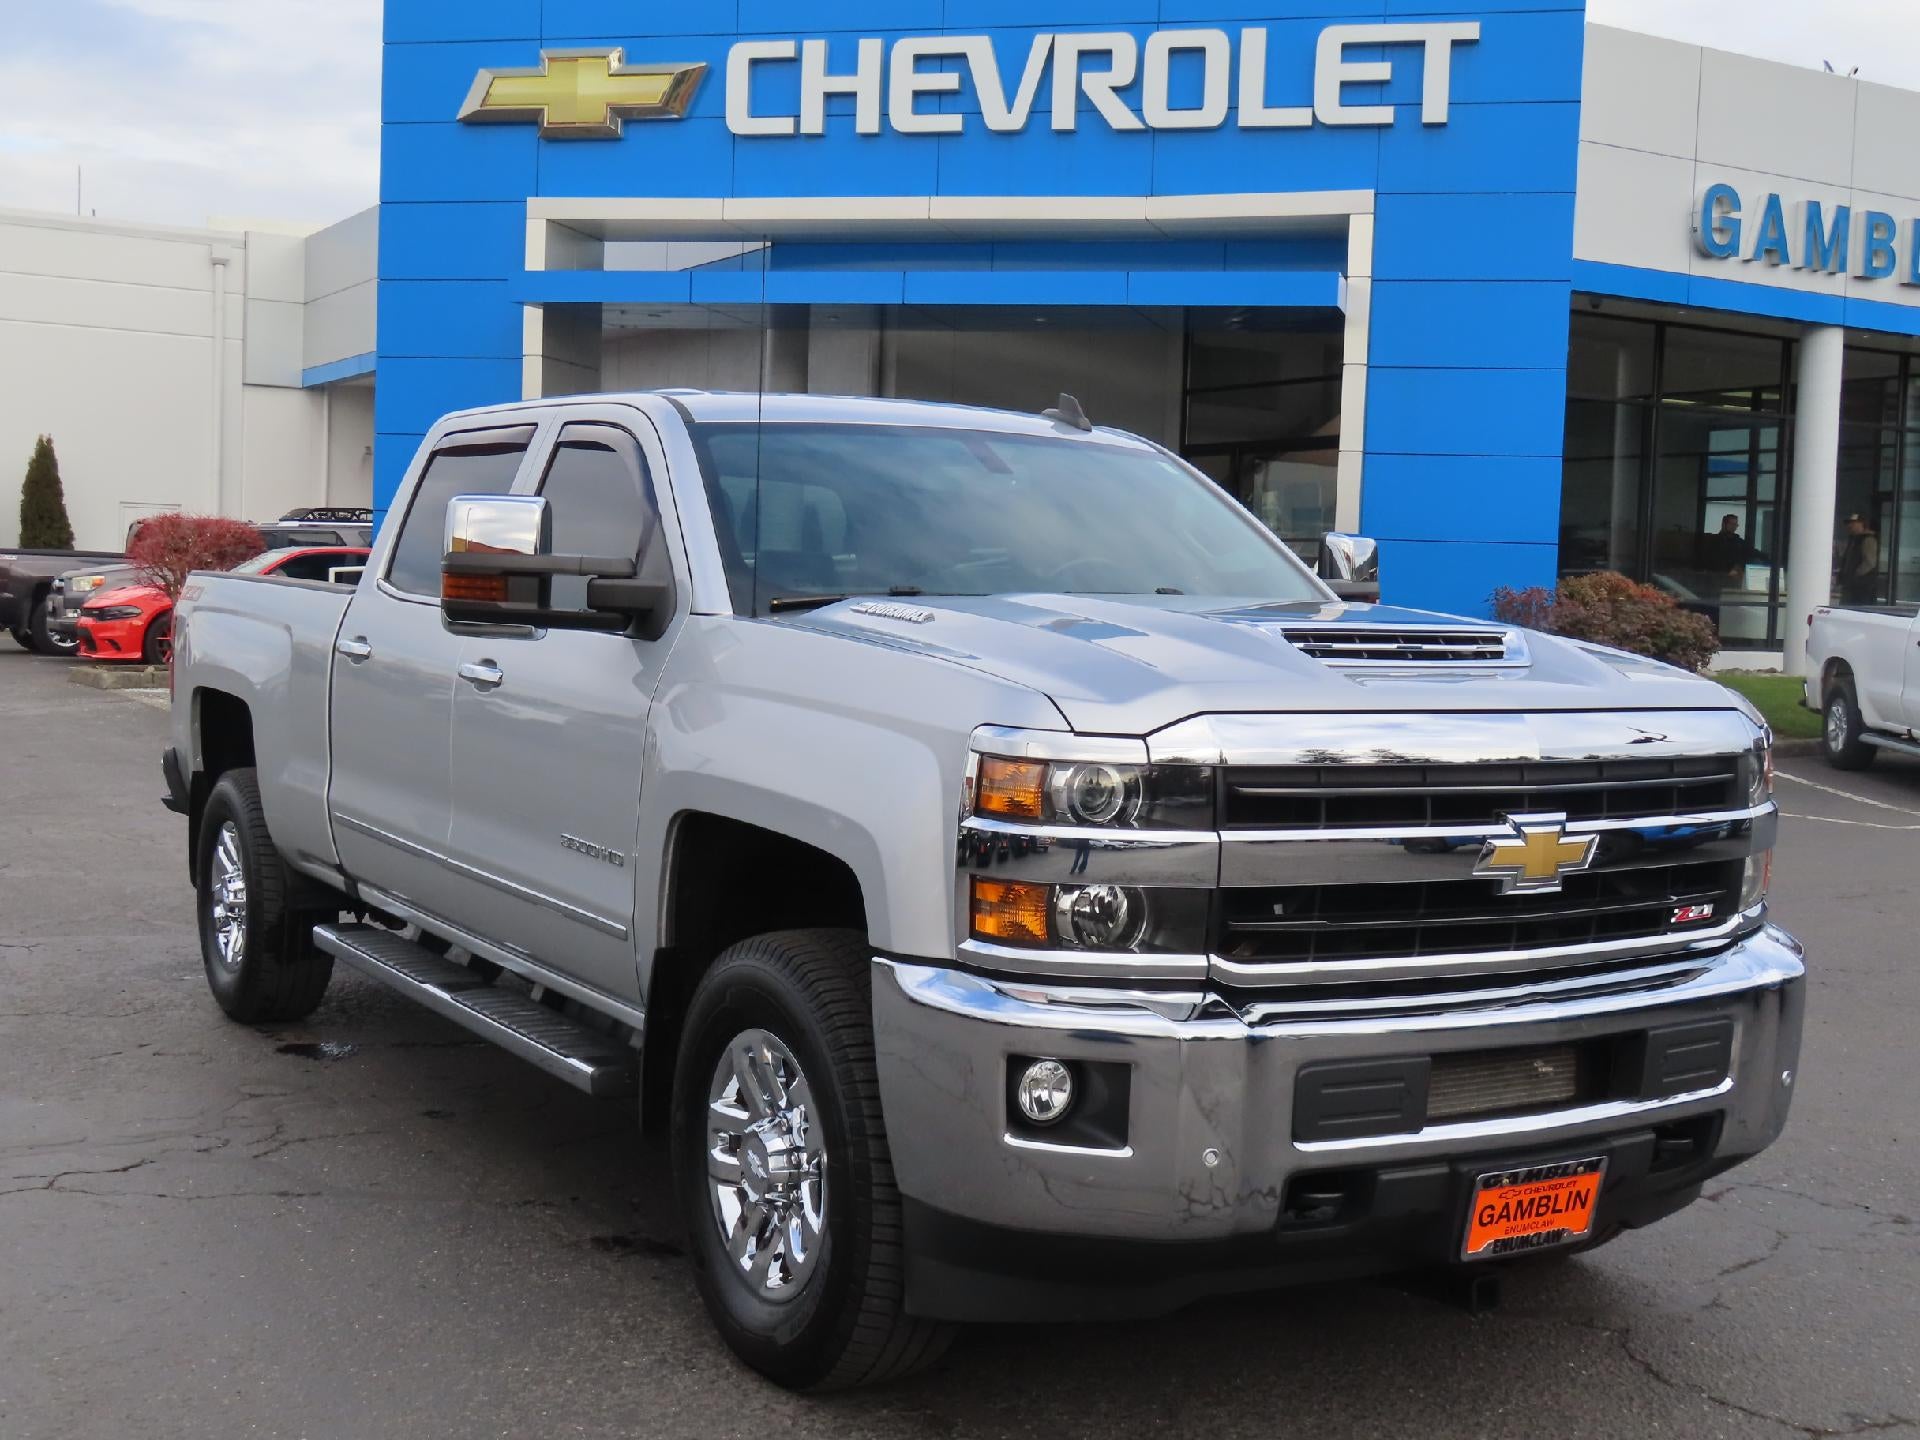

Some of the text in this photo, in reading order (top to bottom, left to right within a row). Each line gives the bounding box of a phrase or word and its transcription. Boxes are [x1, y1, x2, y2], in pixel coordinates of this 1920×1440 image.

[725, 22, 1480, 137] CHEVROLET
[1694, 183, 1920, 286] GAMB
[1523, 1180, 1577, 1195] CHEVROLET
[1478, 1188, 1591, 1227] GAMBLIN
[1492, 1228, 1565, 1254] ENUMCLAW
[1504, 1218, 1555, 1235] ENUMCLAW
